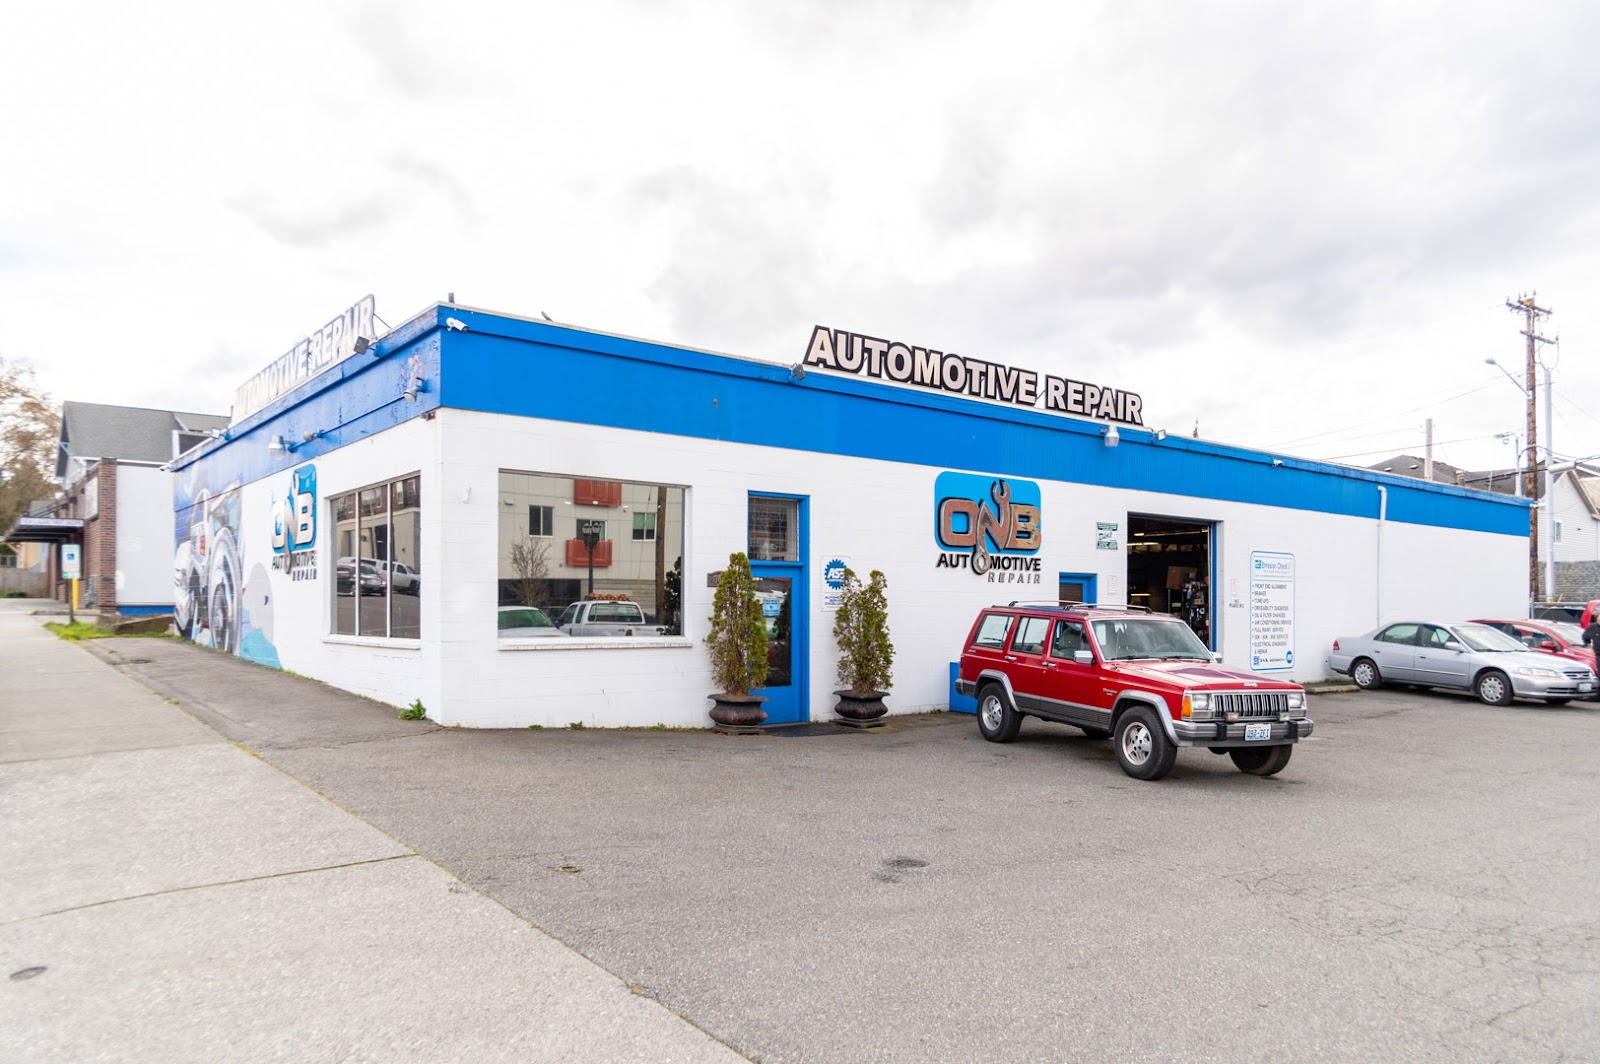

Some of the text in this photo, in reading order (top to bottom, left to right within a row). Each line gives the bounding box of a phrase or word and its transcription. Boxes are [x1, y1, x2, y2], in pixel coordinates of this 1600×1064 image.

[312, 294, 375, 373] REPAIR
[803, 325, 1143, 426] AUTOMOTIVE REPAIR
[271, 481, 314, 553] ONB
[938, 482, 1042, 554] ONB
[292, 568, 317, 581] REPAIR
[936, 553, 1042, 573] AUTOMOTIVE
[987, 571, 1041, 584] REPAIR
